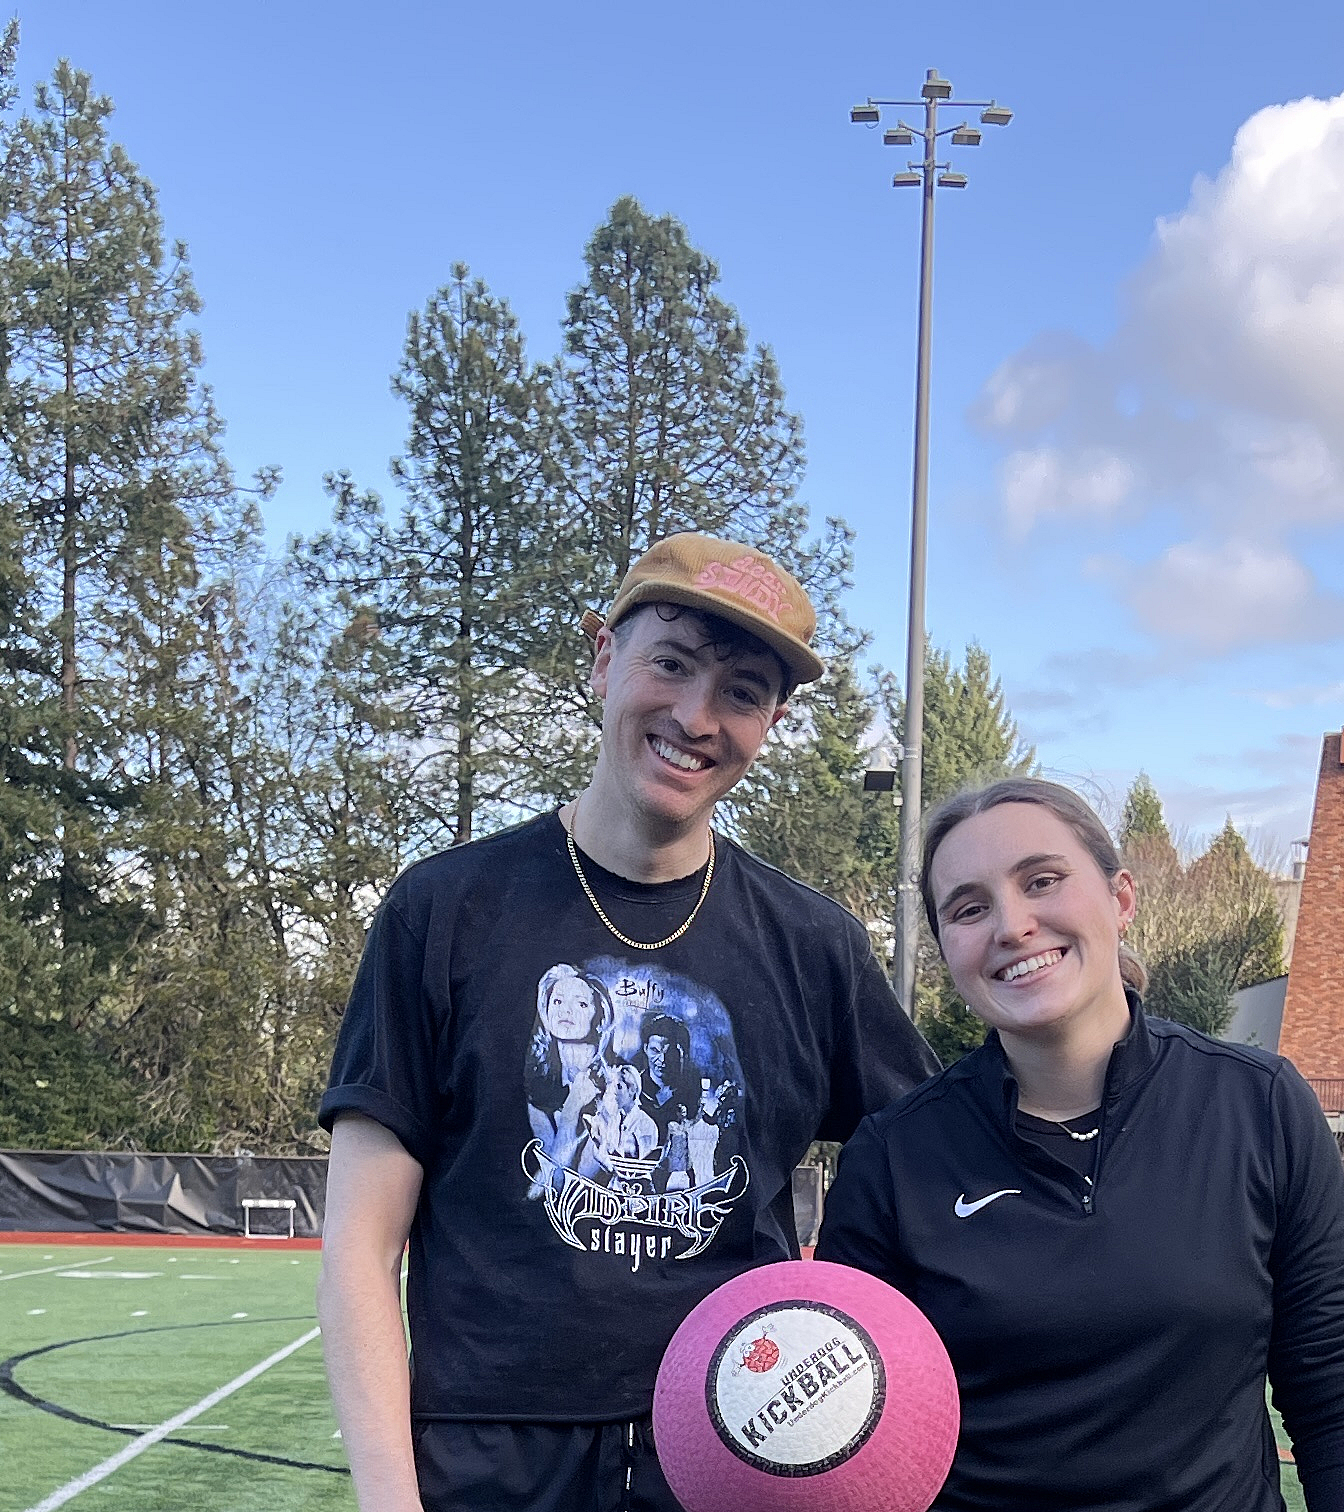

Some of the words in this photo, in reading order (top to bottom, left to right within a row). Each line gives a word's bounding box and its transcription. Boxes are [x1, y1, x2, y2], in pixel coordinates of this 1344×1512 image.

[615, 979, 664, 1009] Buffy
[590, 1226, 672, 1272] slayer
[779, 1337, 843, 1387] UNDERDOG
[740, 1342, 864, 1449] KICKBALL
